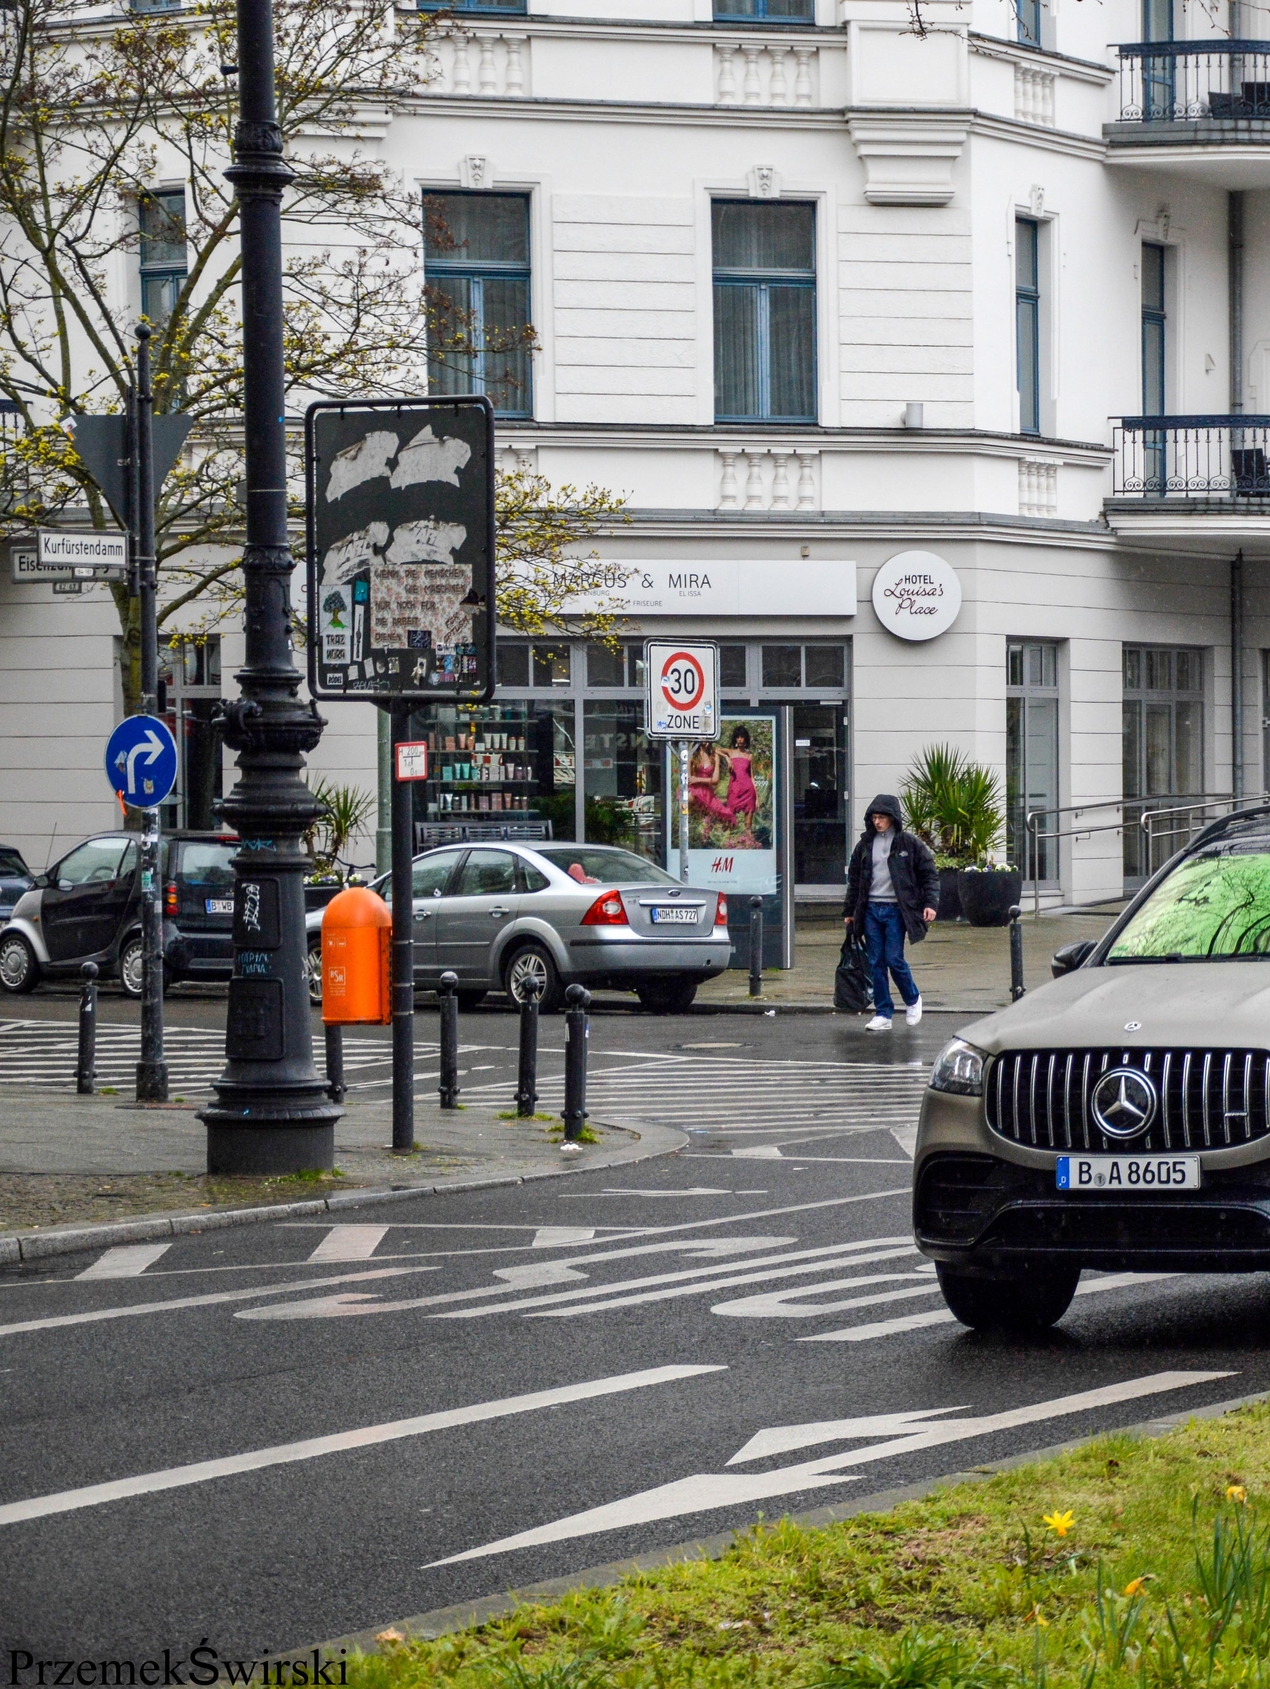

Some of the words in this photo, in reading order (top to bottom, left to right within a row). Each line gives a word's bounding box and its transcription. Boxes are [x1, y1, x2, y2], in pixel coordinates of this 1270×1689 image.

[44, 537, 123, 557] Kurfürstendamm
[553, 573, 627, 589] MARCUS
[641, 573, 654, 589] &
[668, 573, 712, 589] MIRA
[884, 578, 944, 598] Louisa's
[904, 575, 934, 584] HOTEL
[895, 597, 938, 615] Place
[670, 668, 695, 695] 30
[667, 714, 700, 730] ZONE
[711, 856, 734, 873] H&M
[658, 909, 670, 920] NDH
[684, 910, 697, 920] 727
[1078, 1161, 1093, 1185] B
